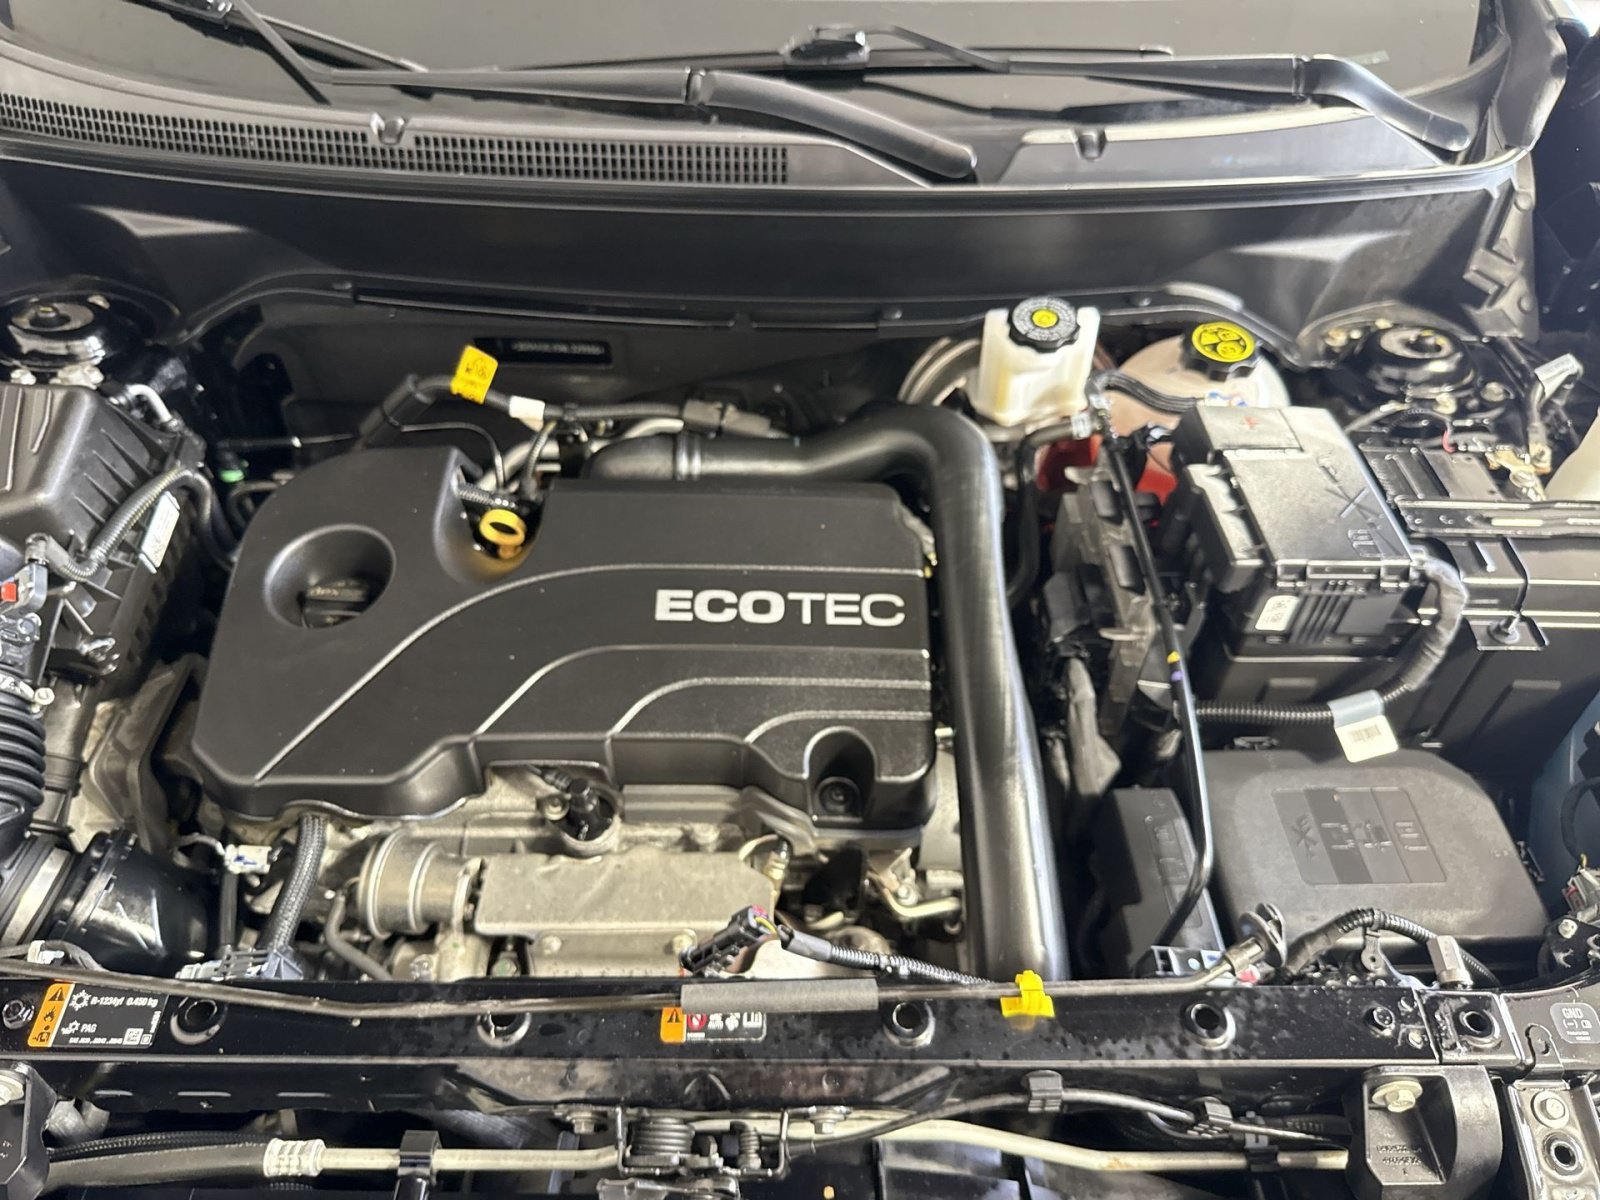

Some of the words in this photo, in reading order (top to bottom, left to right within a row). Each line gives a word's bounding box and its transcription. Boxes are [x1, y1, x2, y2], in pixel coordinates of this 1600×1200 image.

[655, 589, 906, 627] ECOTEC
[148, 998, 158, 1008] kg
[1562, 1008, 1583, 1018] GND
[80, 1023, 97, 1033] PAG
